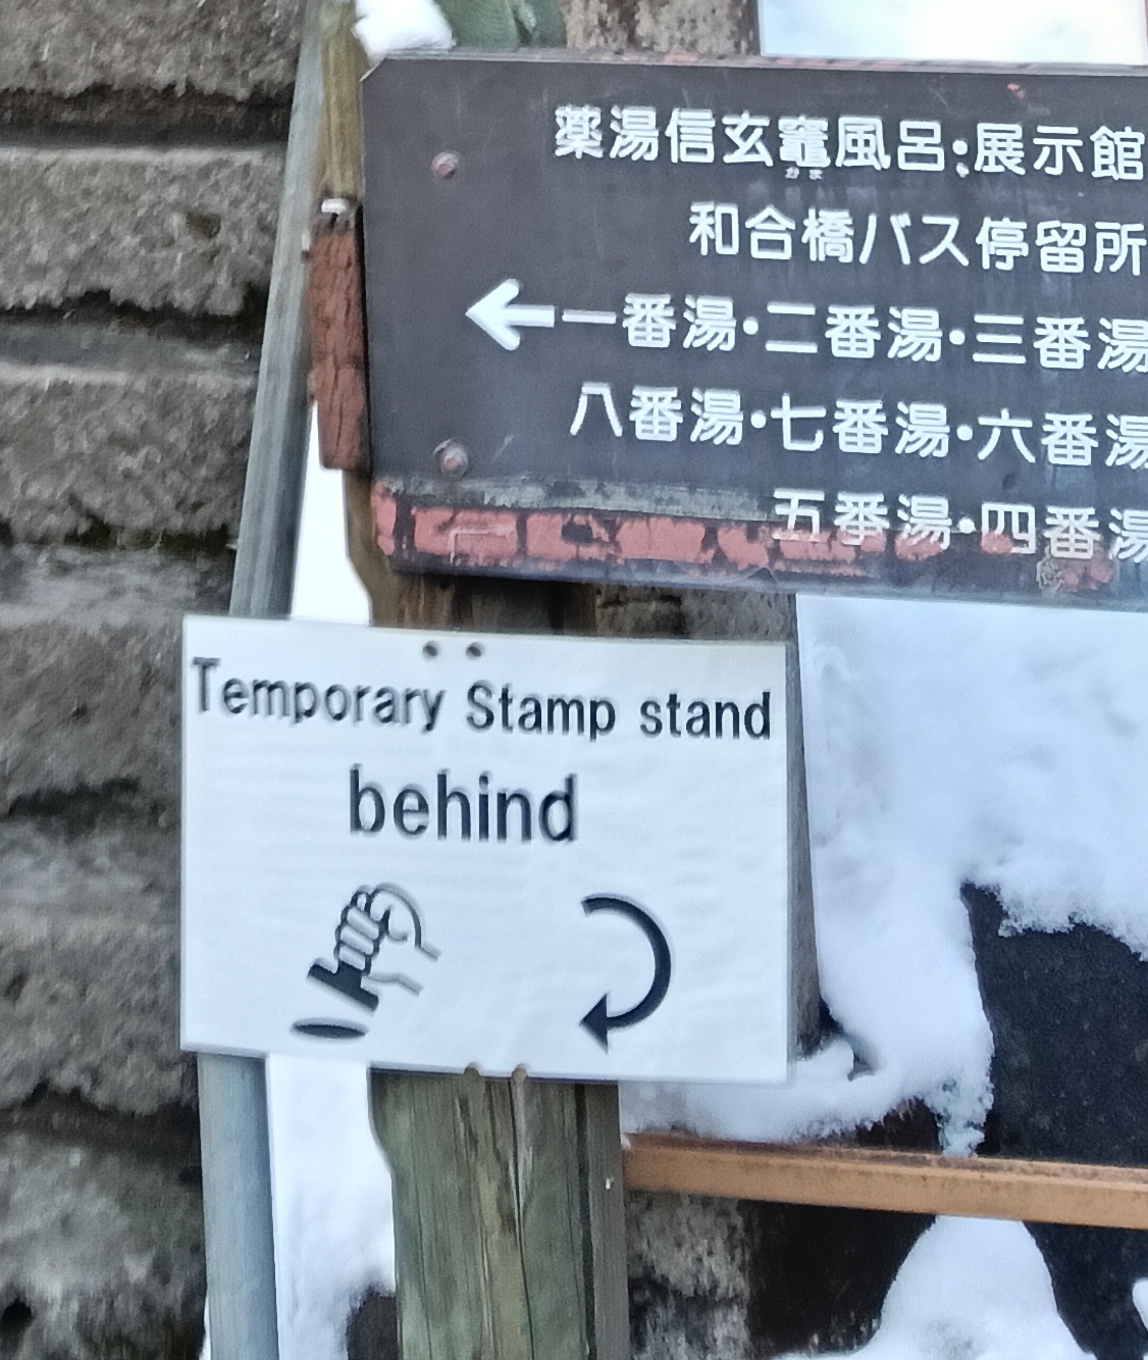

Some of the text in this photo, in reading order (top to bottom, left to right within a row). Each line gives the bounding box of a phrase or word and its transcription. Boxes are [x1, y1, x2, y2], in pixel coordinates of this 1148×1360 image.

[688, 200, 1148, 277] 和合橋バス停留所
[192, 657, 773, 741] Temporary Stamp stand
[349, 763, 579, 843] behind
